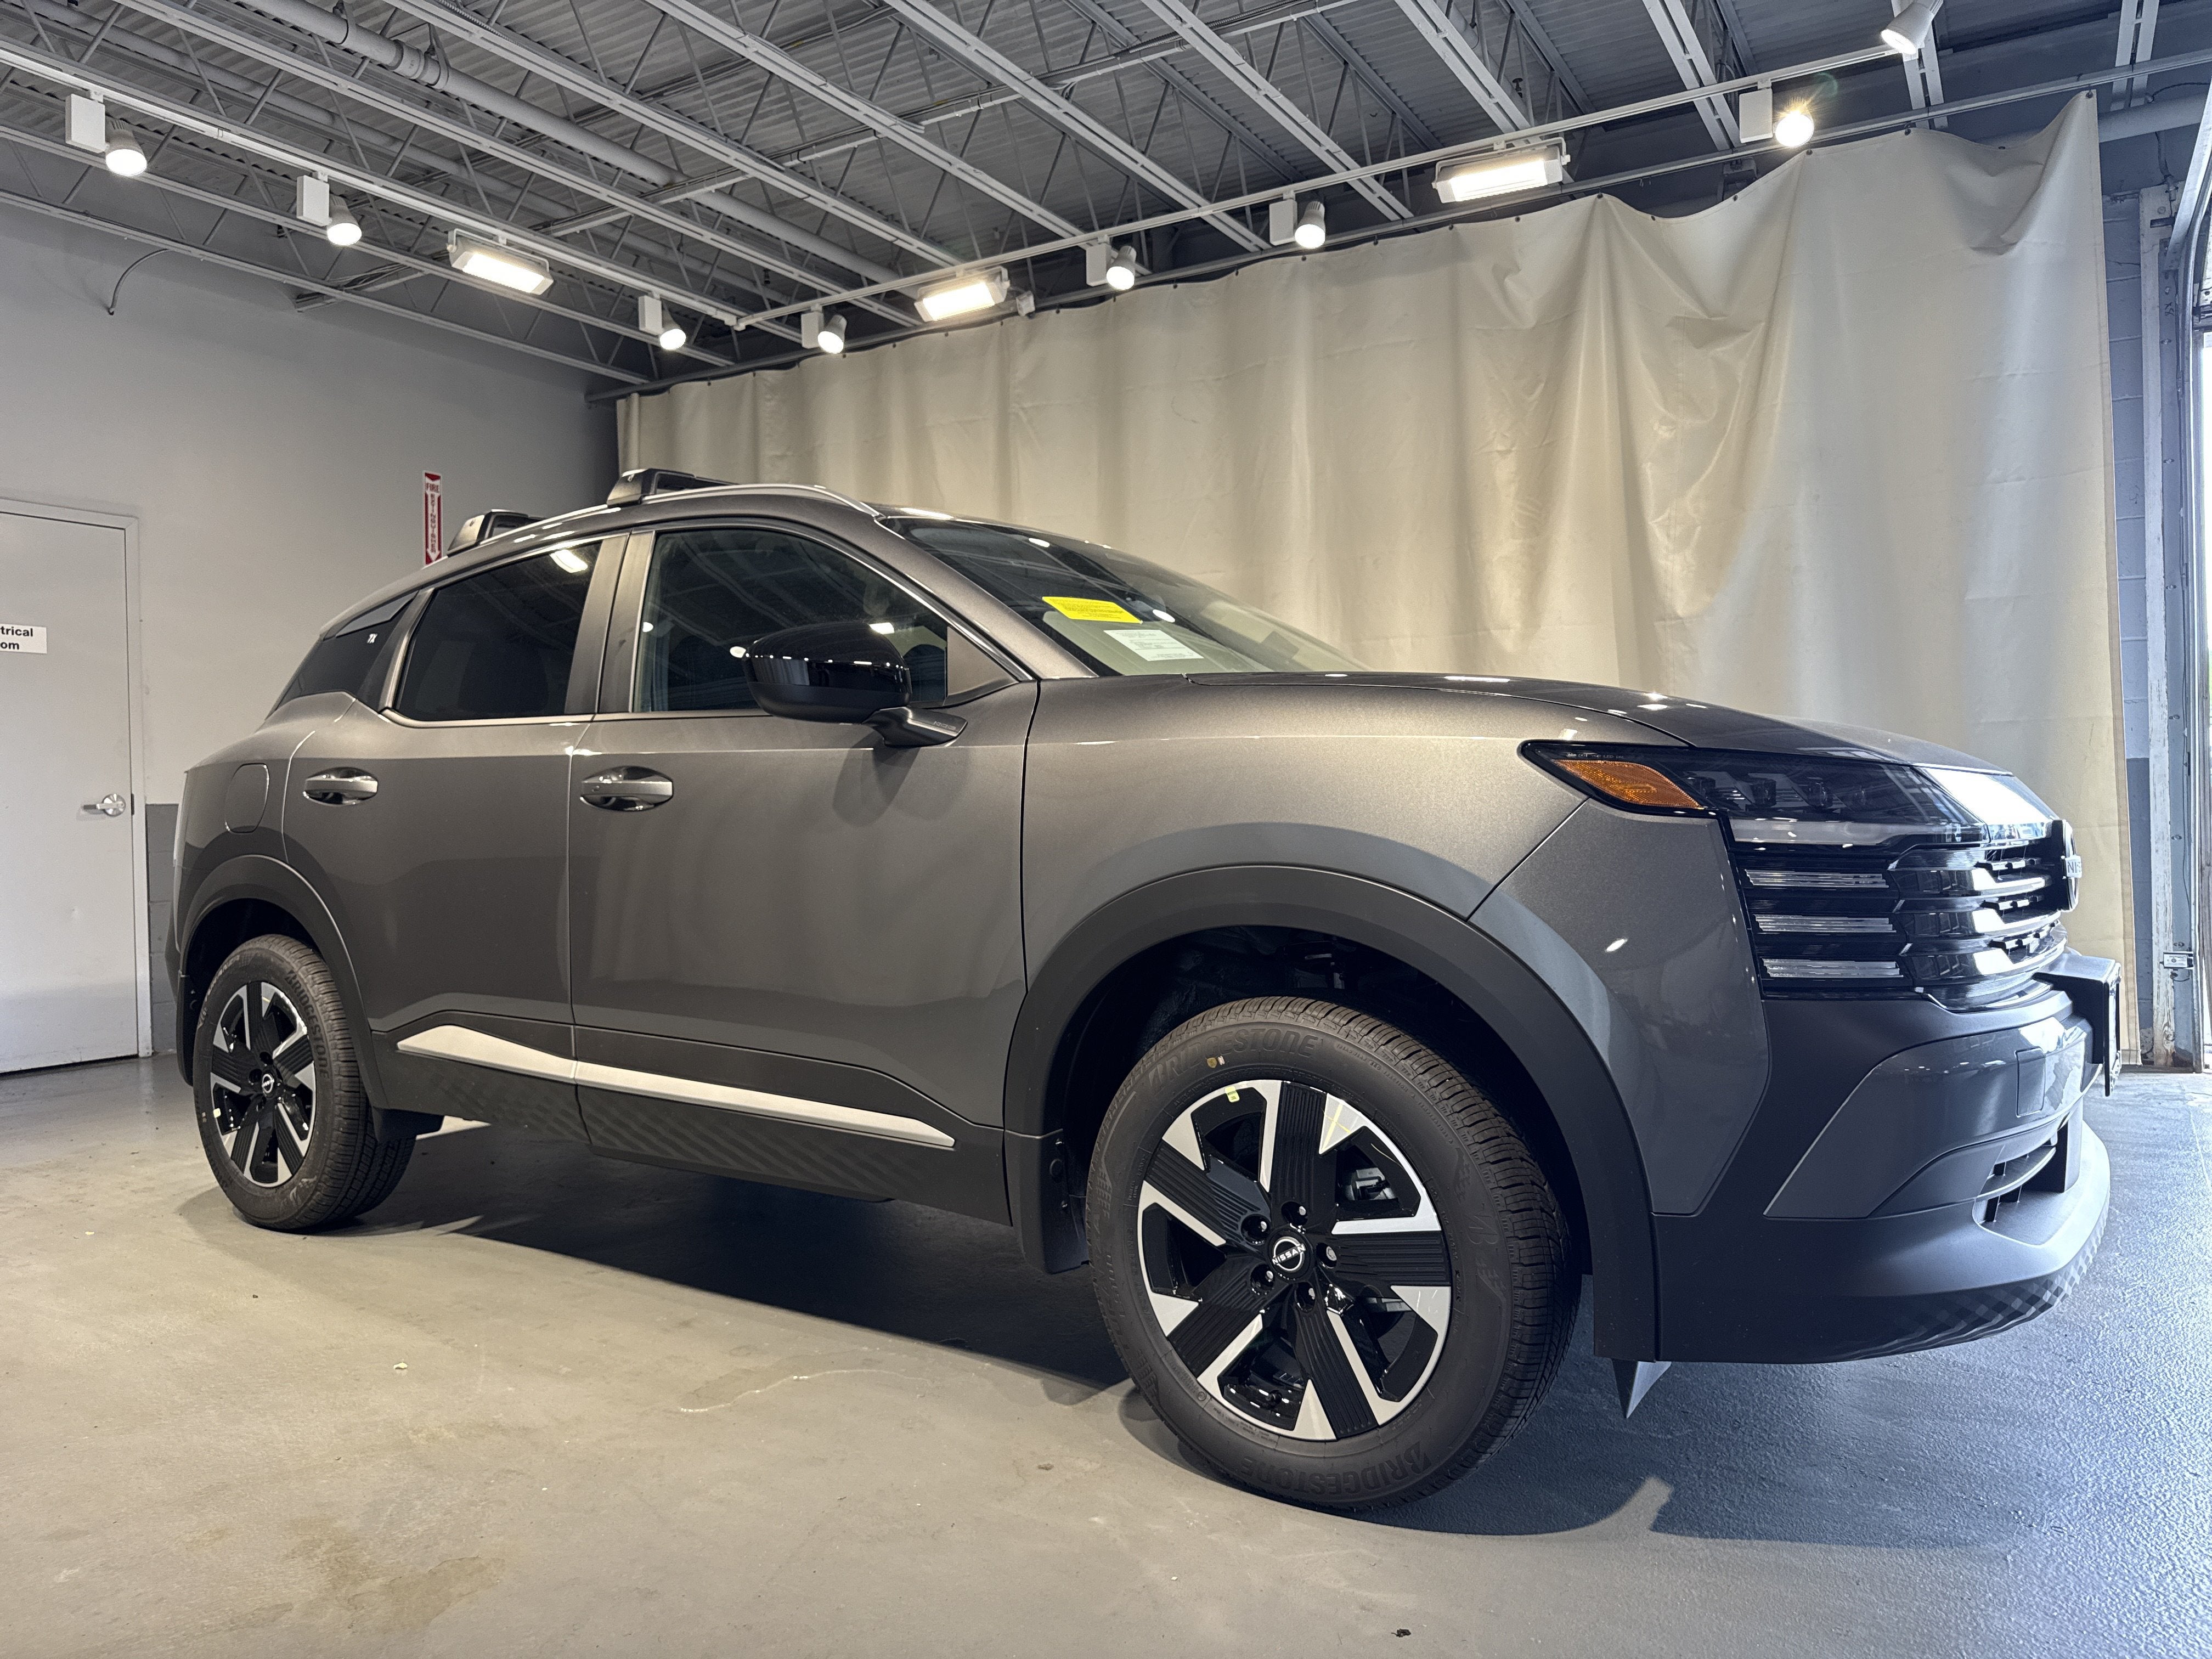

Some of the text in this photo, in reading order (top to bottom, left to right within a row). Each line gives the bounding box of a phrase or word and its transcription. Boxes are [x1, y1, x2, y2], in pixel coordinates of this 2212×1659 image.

[425, 482, 440, 493] FIRE
[0, 625, 33, 637] trical
[284, 969, 330, 1080] BRIDGESTONE
[1147, 1028, 1318, 1092] BRIDGESTONE
[1272, 1243, 1306, 1265] NISSAN
[1242, 1442, 1432, 1496] BRIDGESTONE
